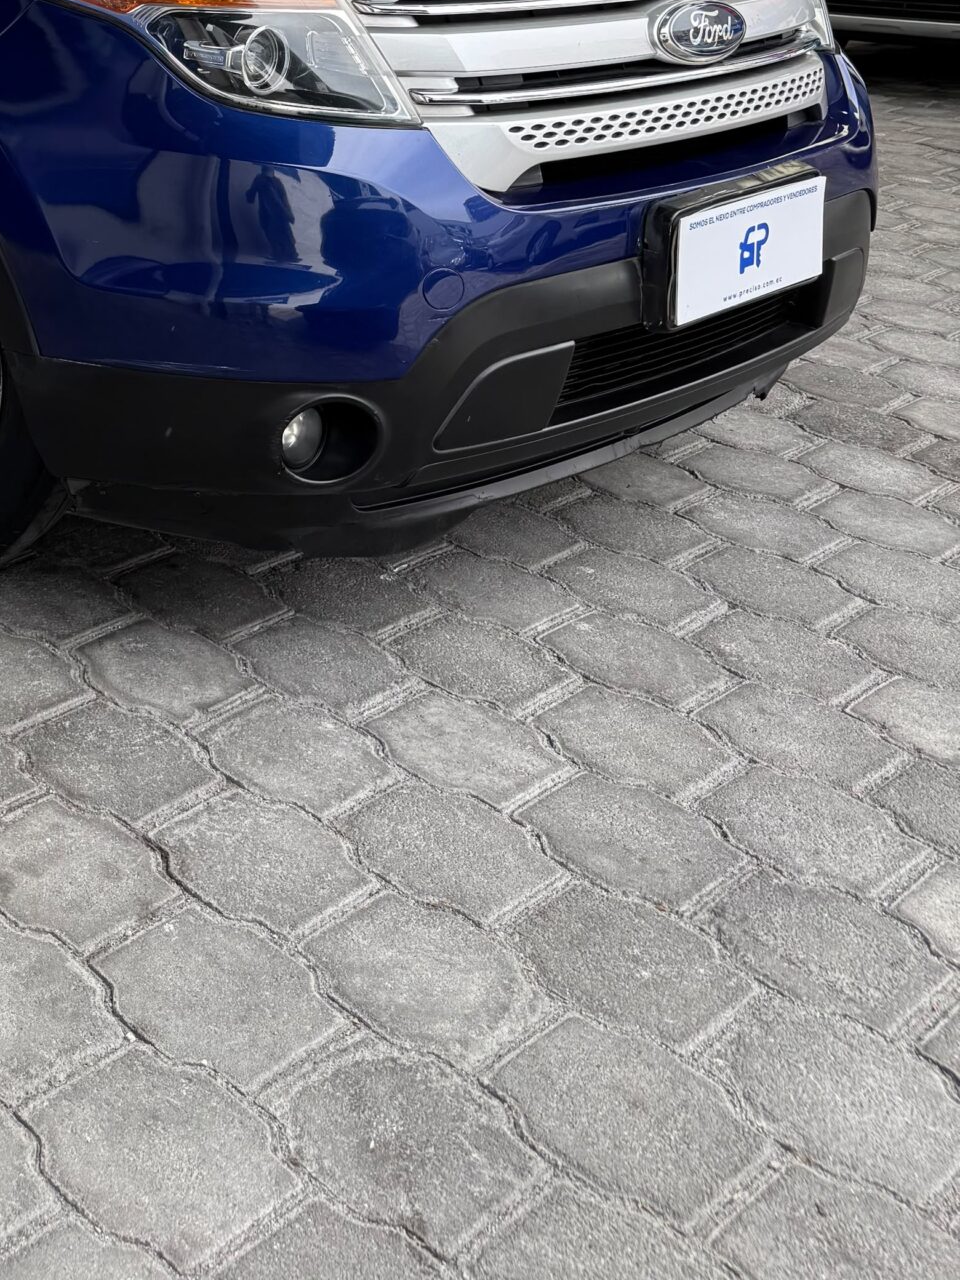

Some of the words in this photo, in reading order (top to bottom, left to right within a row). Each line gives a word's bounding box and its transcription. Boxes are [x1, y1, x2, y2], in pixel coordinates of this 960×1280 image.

[689, 10, 734, 47] Ford
[689, 218, 708, 231] SOMOS
[709, 216, 715, 225] EL
[715, 212, 730, 222] NEXO
[730, 206, 746, 218] ENTRE
[746, 195, 783, 213] COMPRADORES
[787, 185, 818, 200] VENDEDORES
